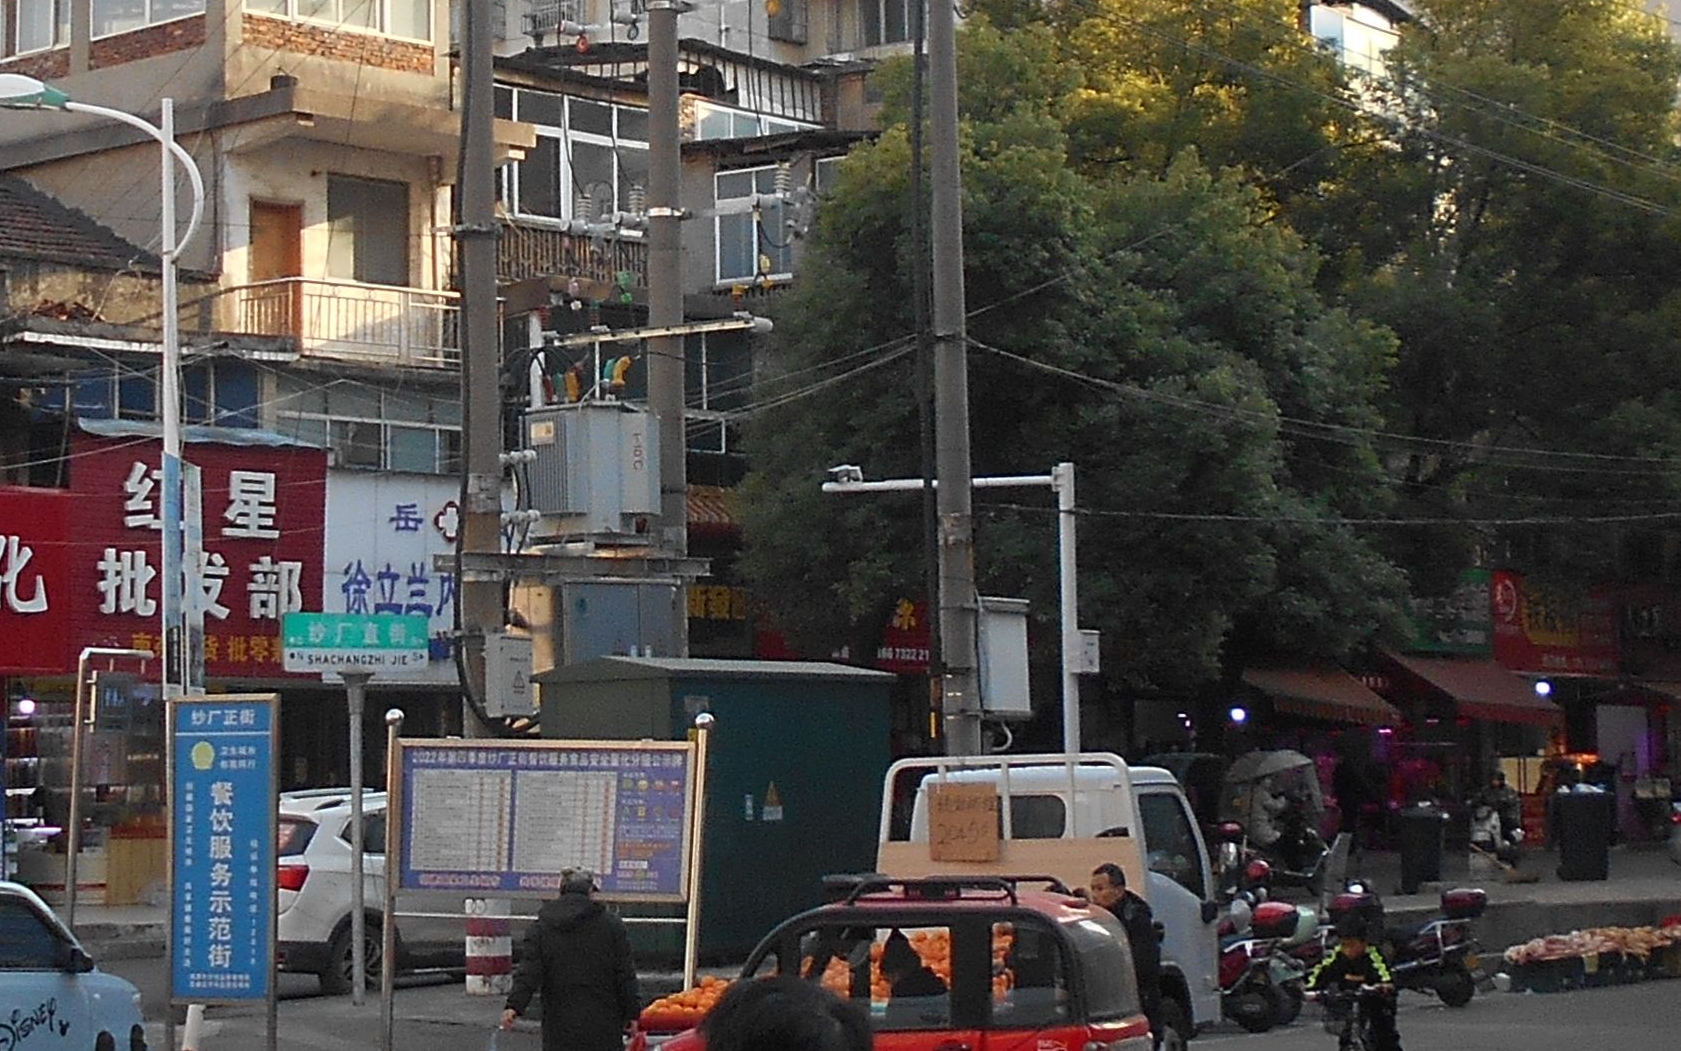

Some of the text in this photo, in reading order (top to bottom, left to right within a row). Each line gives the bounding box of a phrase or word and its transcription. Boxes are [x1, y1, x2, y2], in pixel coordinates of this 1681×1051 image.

[389, 503, 423, 531] 岳
[97, 548, 303, 620] 批发部
[308, 654, 385, 665] SHACHANGZHI
[392, 655, 408, 665] JIE
[191, 710, 255, 725] 纱厂正街
[208, 781, 234, 968] 餐饮服务示范街
